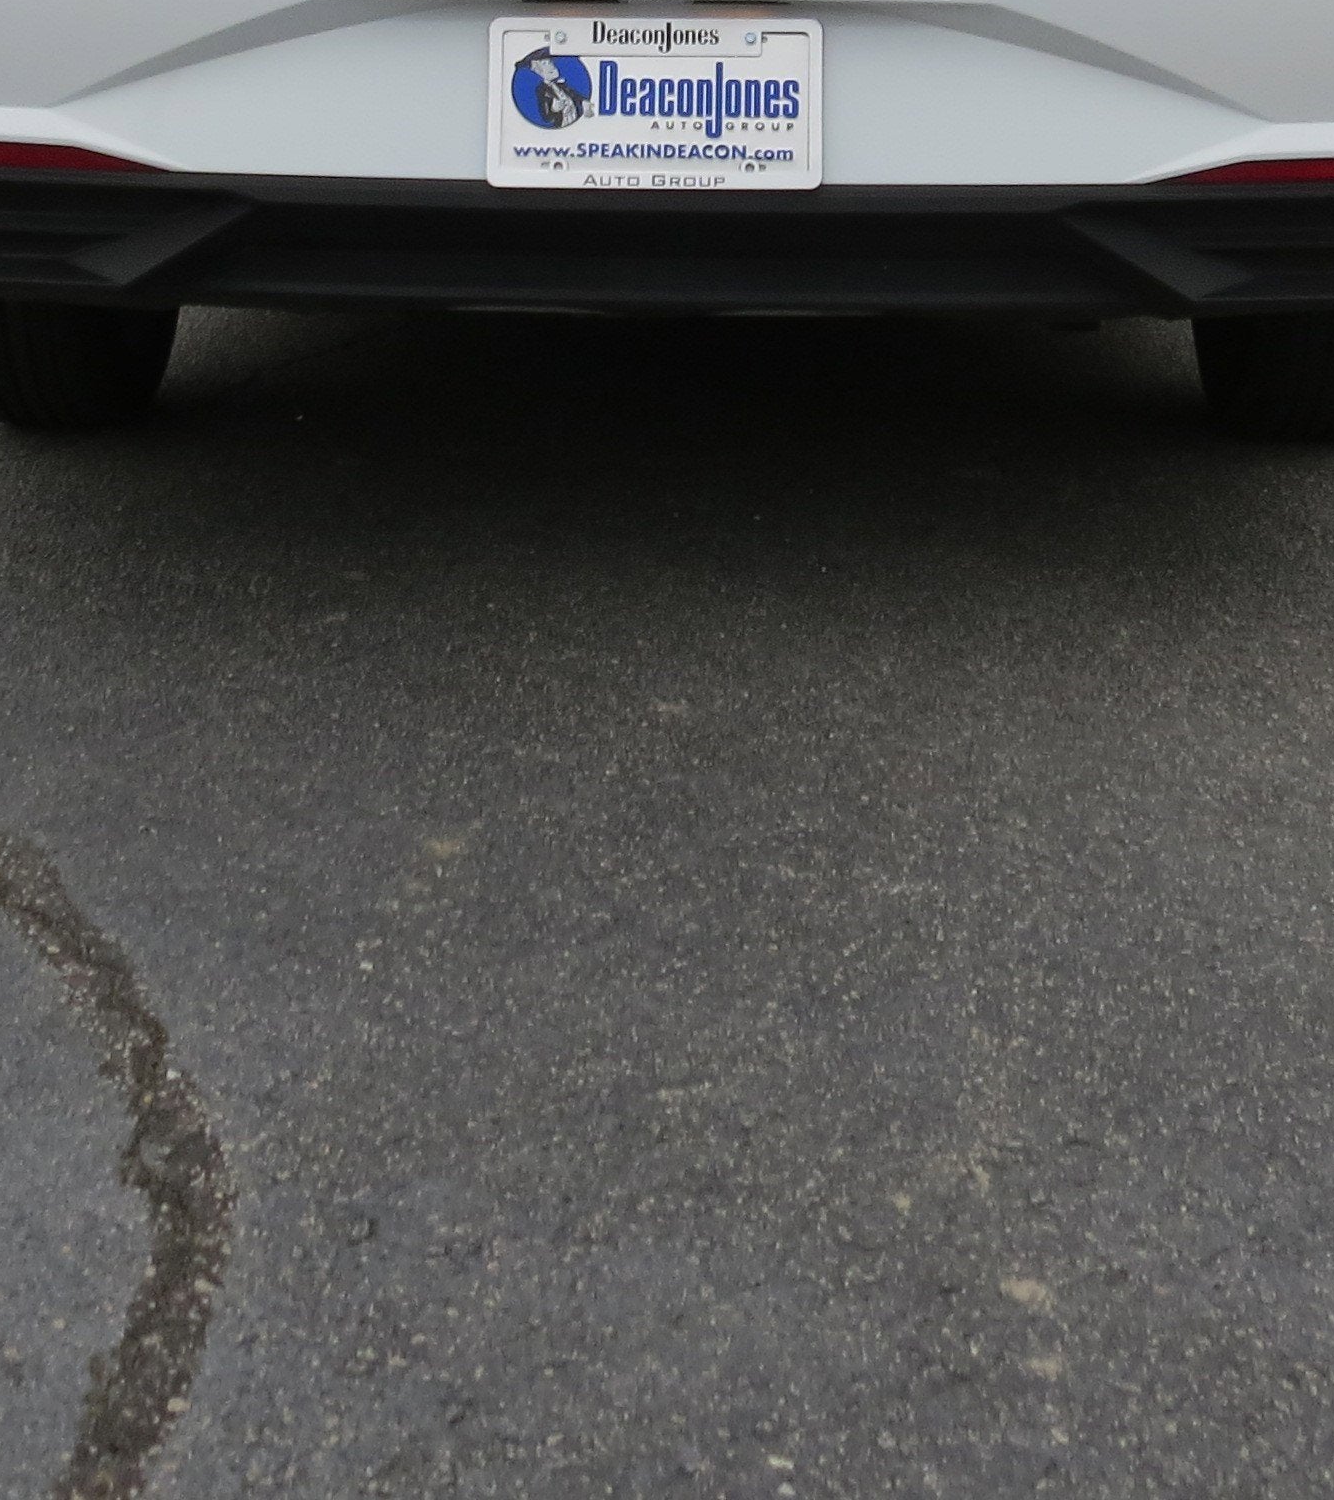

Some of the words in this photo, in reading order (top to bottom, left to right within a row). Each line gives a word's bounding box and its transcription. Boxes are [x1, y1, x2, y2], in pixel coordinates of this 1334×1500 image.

[592, 20, 720, 53] DeaconJones
[598, 60, 800, 139] DeaconJones
[650, 120, 703, 131] AUTO
[725, 122, 795, 132] GROUP
[514, 143, 795, 162] www.SPEAKINDEACON.com
